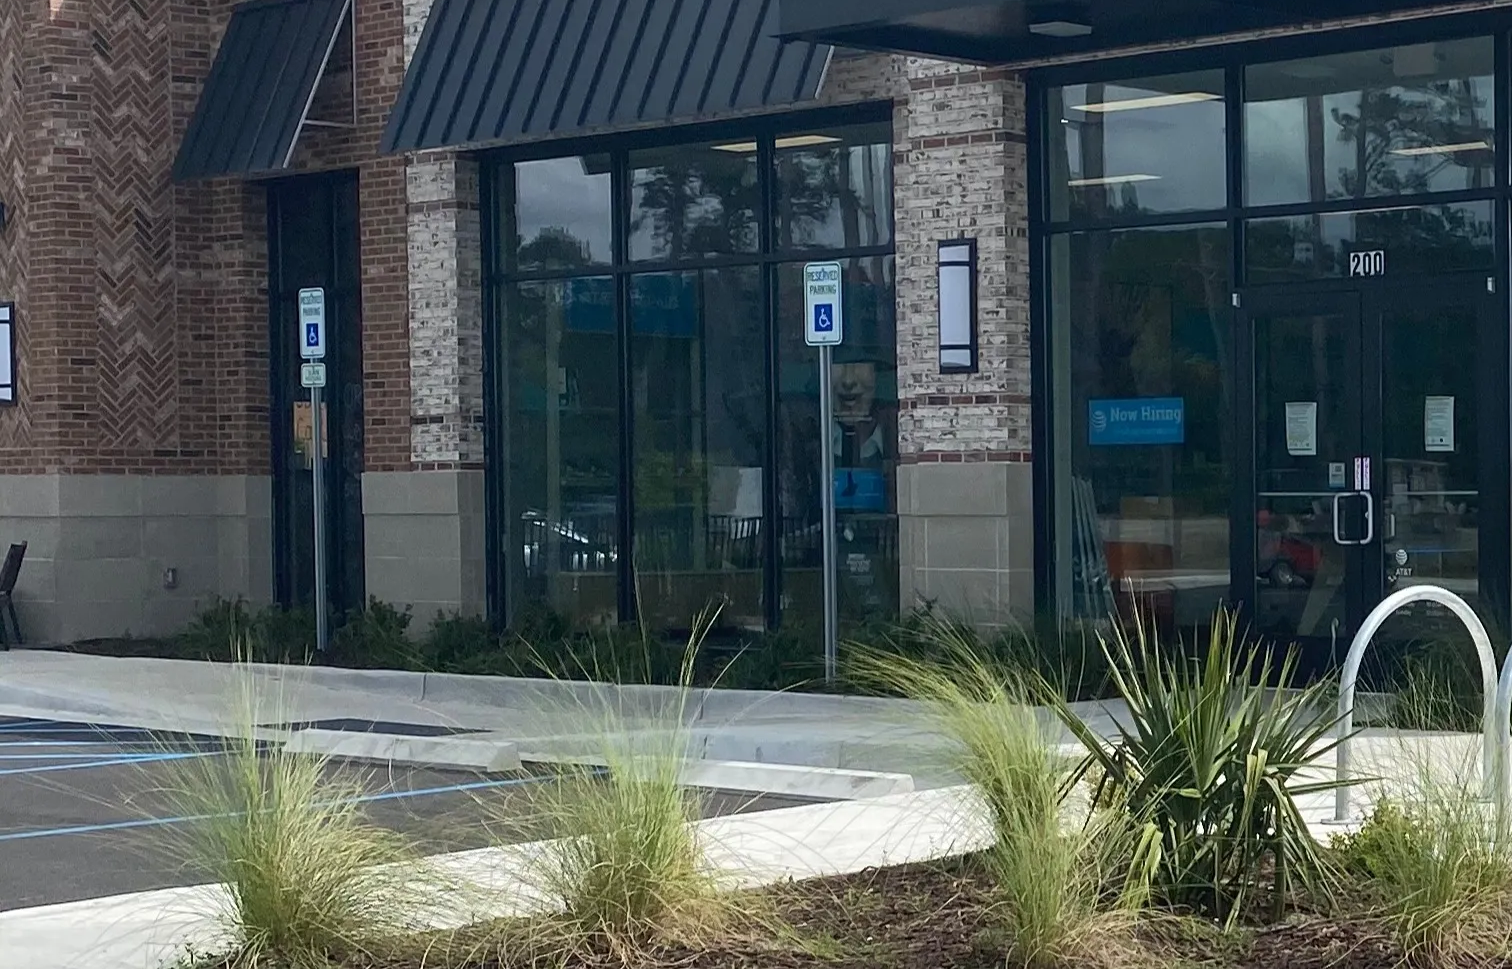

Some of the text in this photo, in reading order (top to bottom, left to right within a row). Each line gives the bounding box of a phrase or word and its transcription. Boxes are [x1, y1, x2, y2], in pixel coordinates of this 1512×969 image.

[1352, 252, 1382, 276] 200
[807, 271, 838, 282] RESERVED
[810, 284, 837, 295] PARKING
[1110, 405, 1182, 424] Now Hiring
[1395, 568, 1412, 576] AT&T
